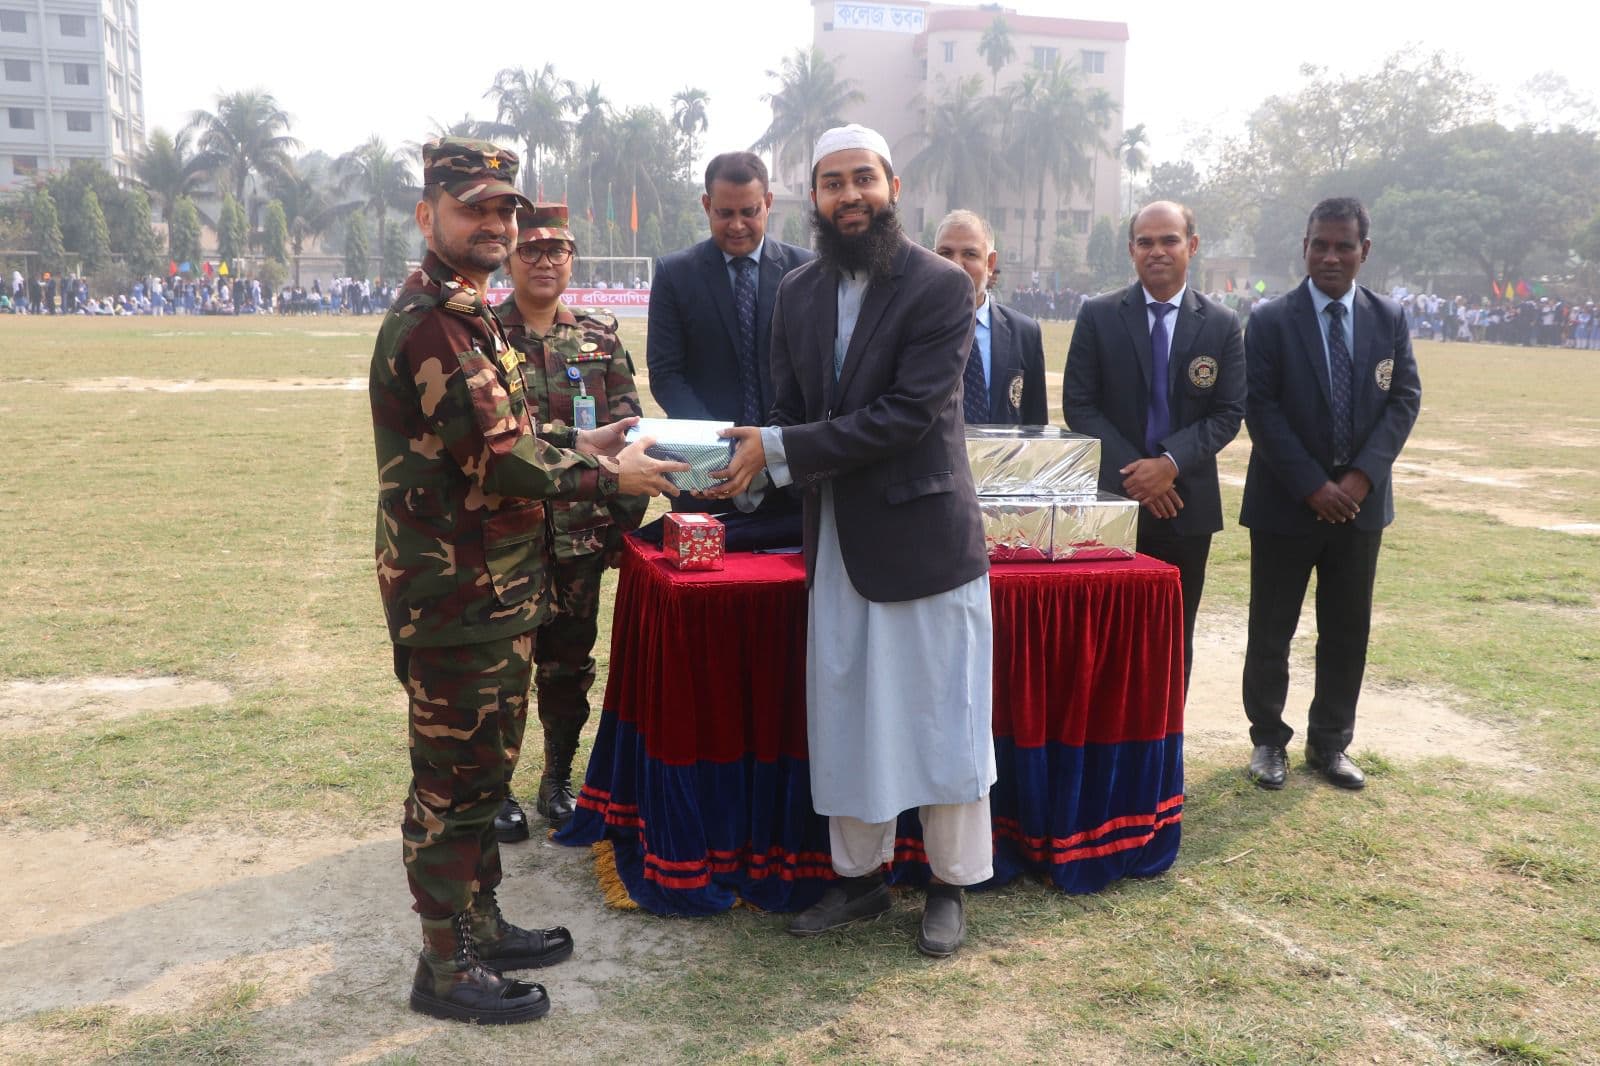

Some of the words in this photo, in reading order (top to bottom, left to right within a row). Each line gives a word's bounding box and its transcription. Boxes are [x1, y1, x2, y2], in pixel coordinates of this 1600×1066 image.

[837, 5, 885, 25] কলেজ
[889, 7, 923, 28] ভবন
[582, 290, 649, 305] প্রতিযোগিত
